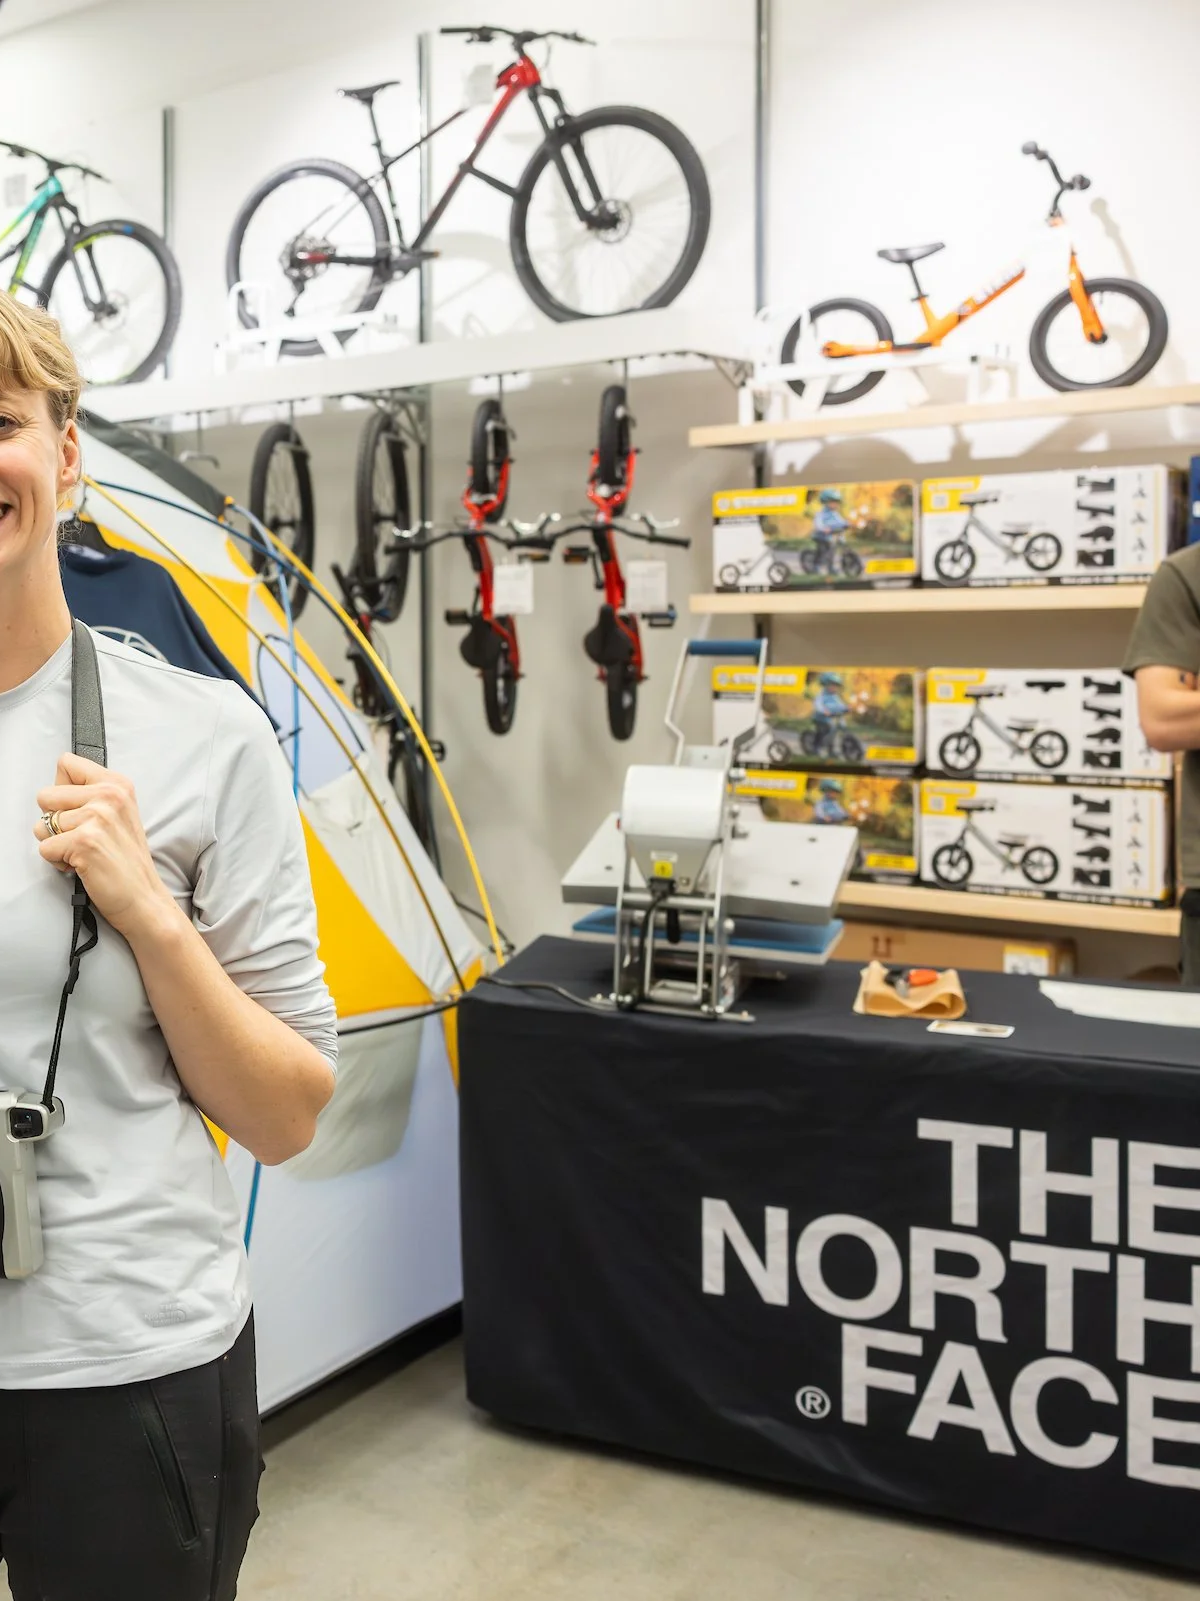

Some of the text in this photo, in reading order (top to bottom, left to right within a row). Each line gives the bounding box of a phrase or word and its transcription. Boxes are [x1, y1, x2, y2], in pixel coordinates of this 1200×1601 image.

[917, 1117, 1200, 1257] THE
[702, 1196, 1200, 1375] NORTH
[841, 1322, 1200, 1490] FACE
